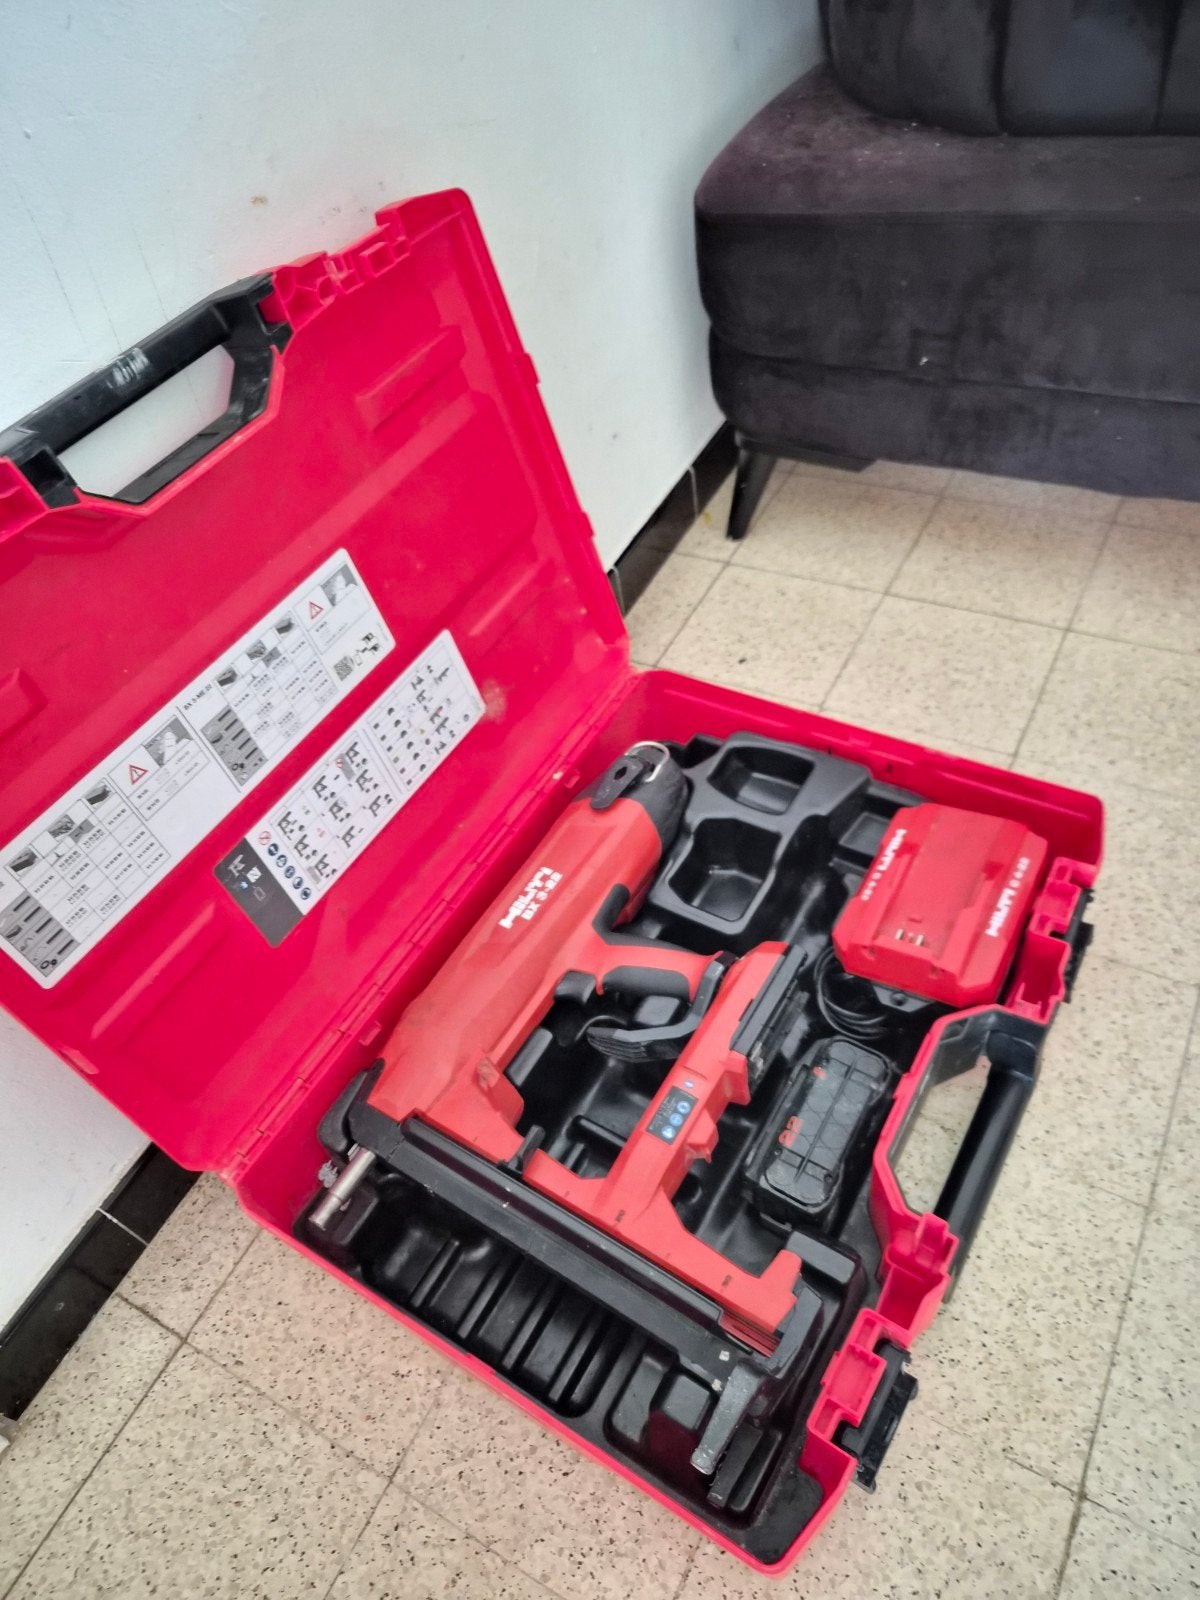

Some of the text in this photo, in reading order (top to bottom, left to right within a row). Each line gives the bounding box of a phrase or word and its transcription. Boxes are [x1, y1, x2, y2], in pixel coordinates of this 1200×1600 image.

[876, 828, 907, 870] HILTI
[498, 866, 554, 930] HILTI
[520, 901, 541, 921] BX
[984, 887, 1017, 938] HILTI
